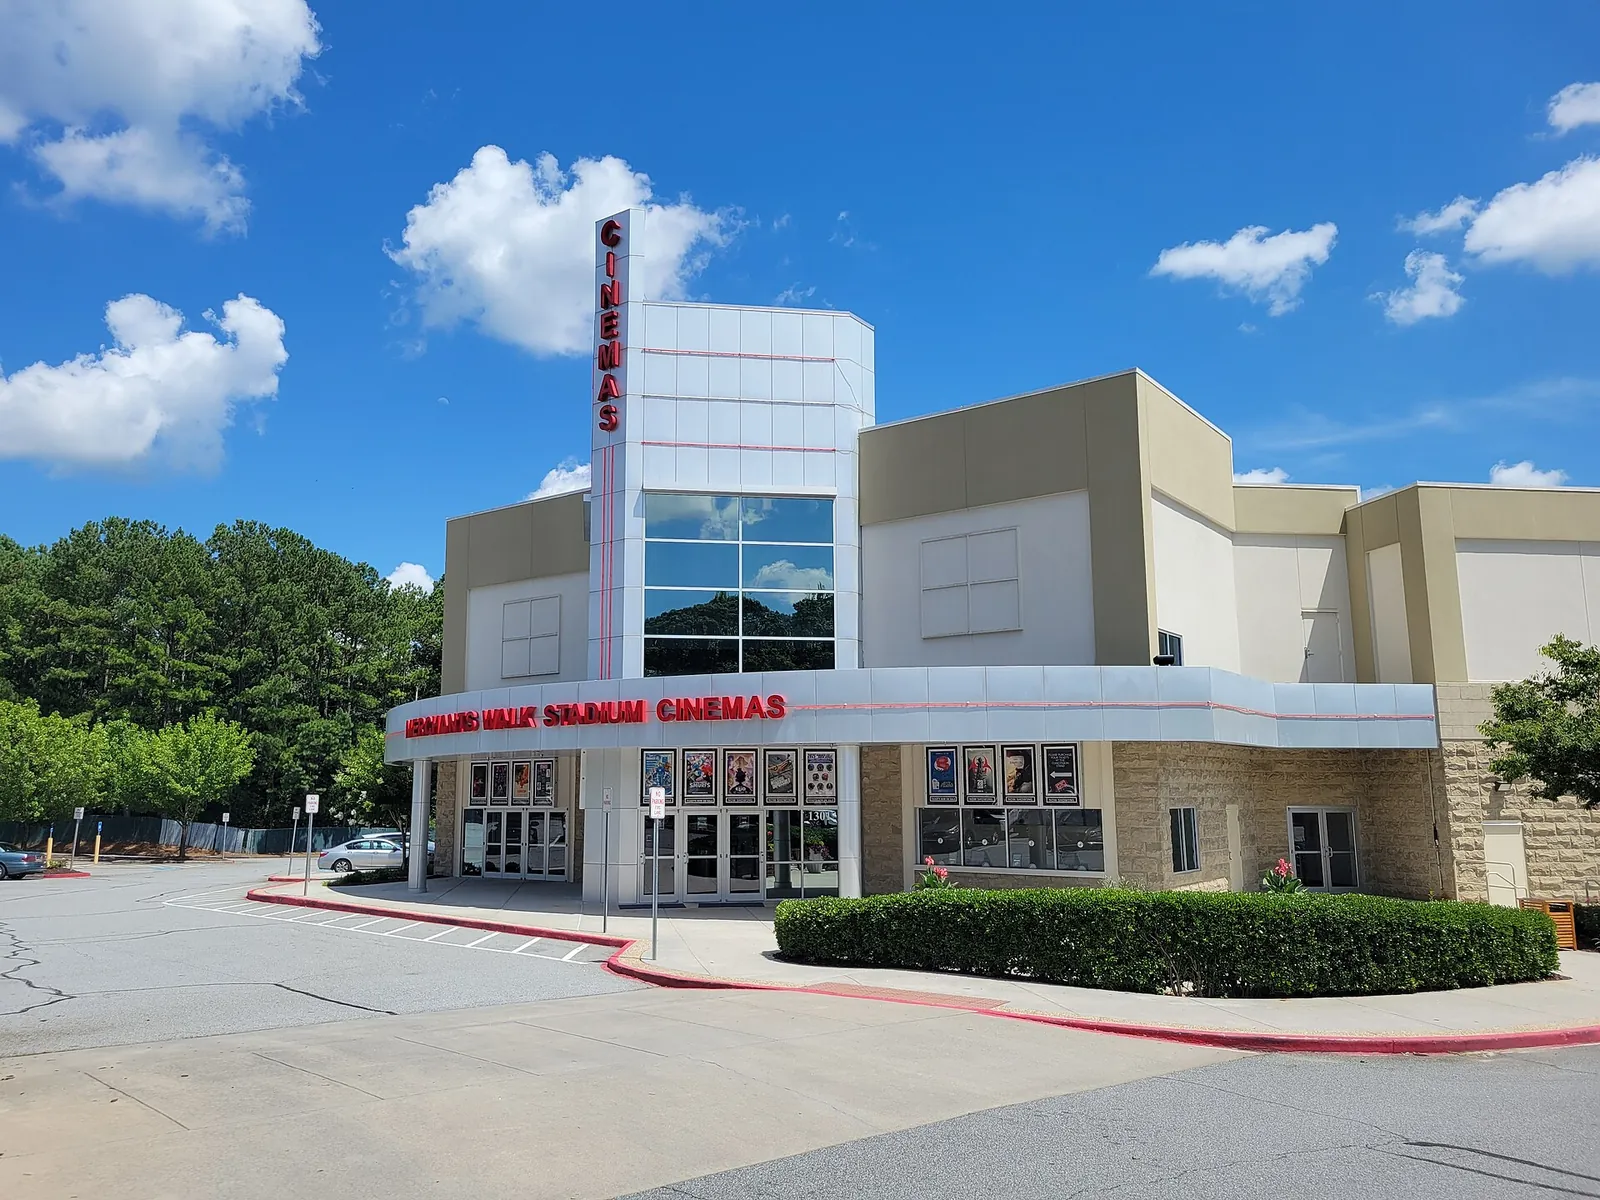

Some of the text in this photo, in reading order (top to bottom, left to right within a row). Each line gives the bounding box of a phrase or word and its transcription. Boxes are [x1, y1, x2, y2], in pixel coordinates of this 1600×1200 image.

[598, 219, 622, 432] CINEMAS
[405, 694, 786, 739] MERCHANTS WALK STADIUM CINEMAS
